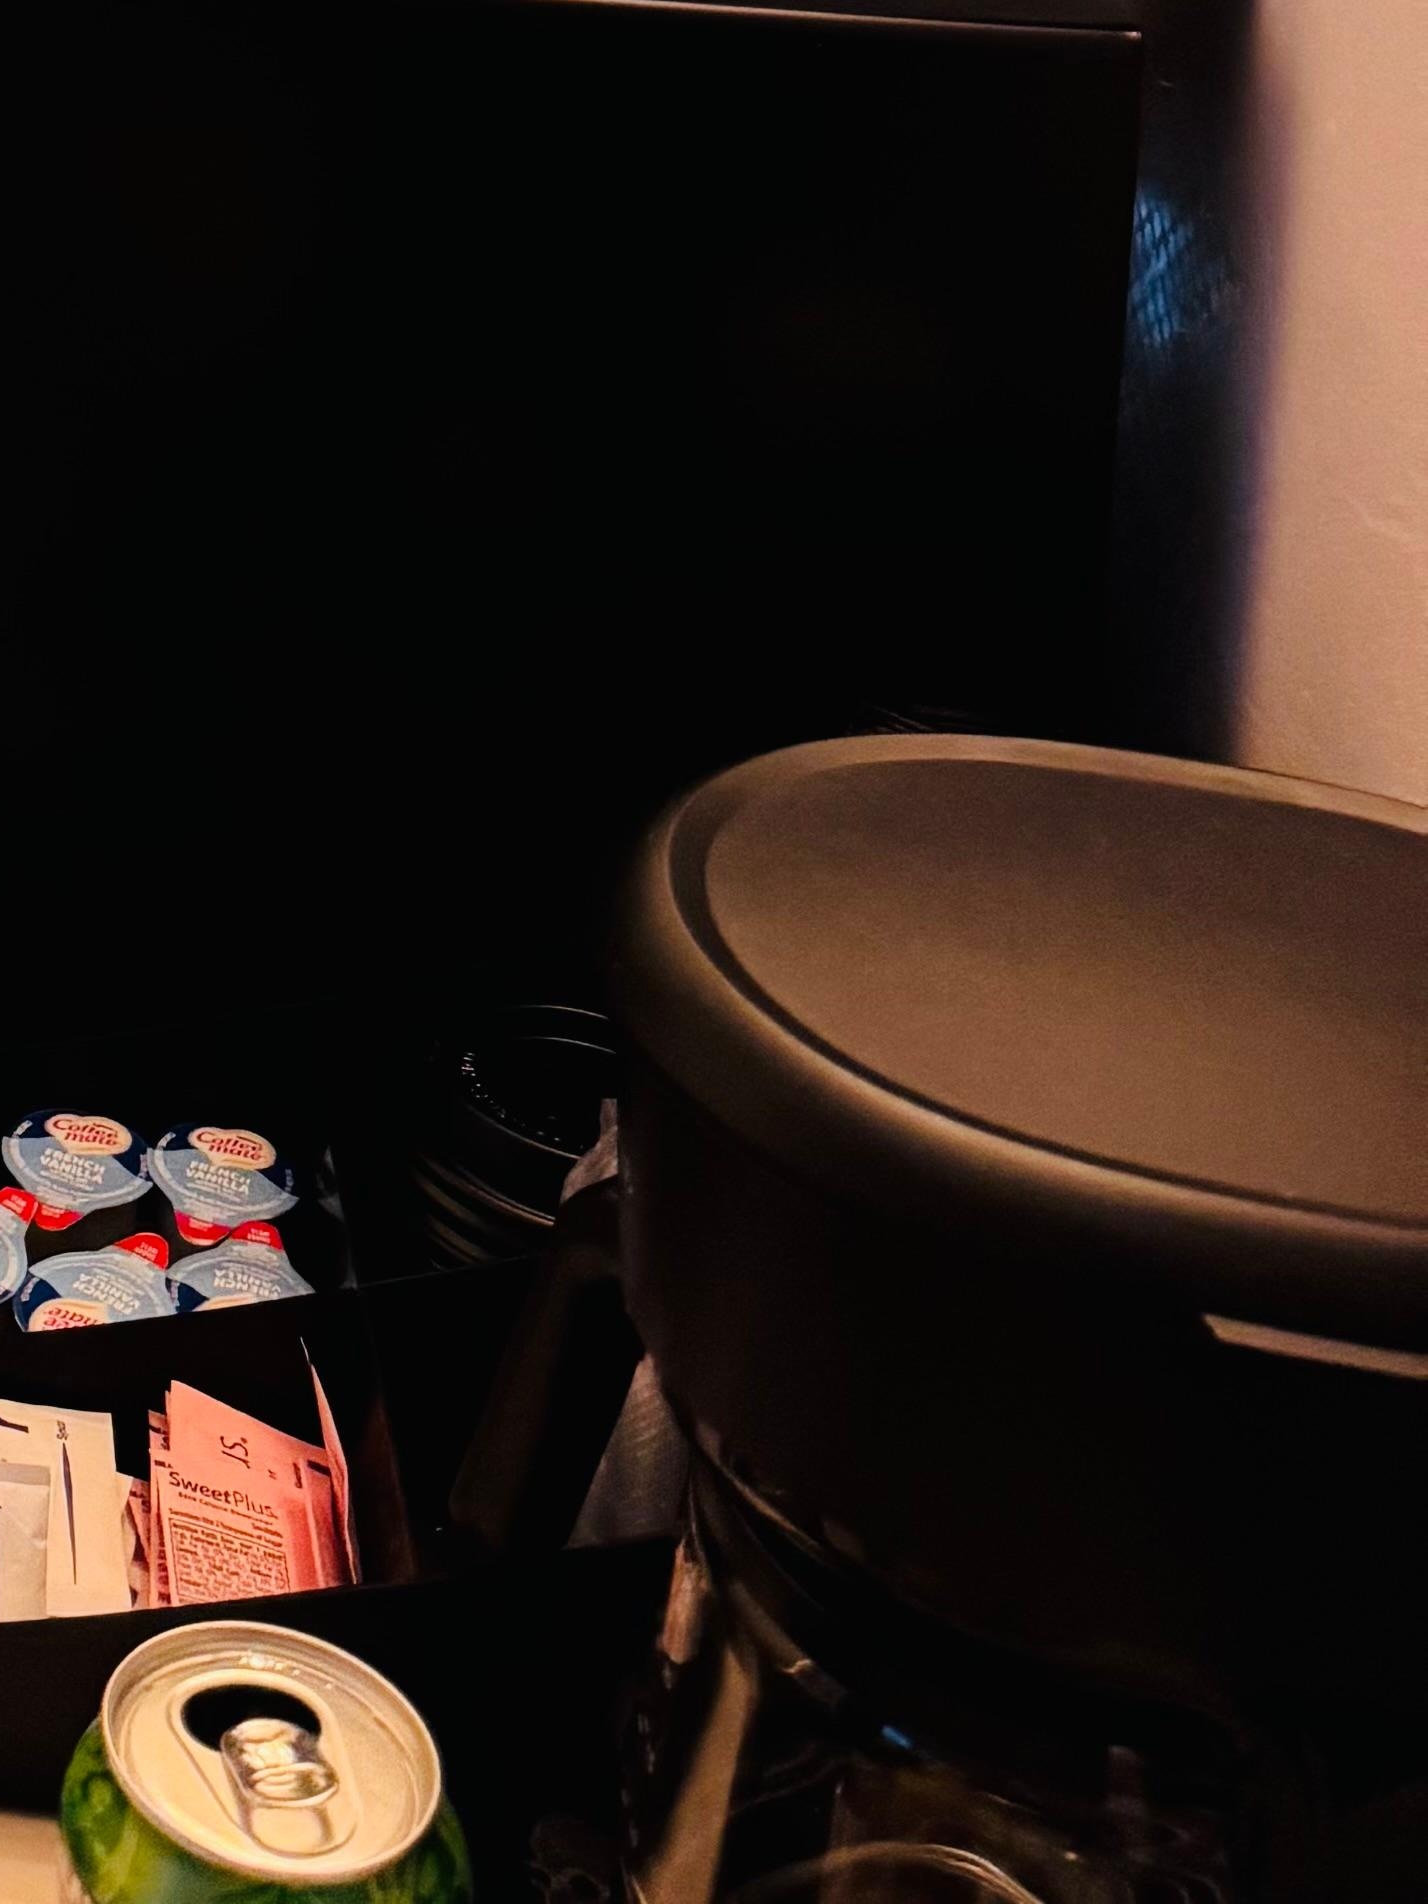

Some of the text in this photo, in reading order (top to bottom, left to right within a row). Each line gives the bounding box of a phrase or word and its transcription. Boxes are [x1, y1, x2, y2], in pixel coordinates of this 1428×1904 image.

[52, 1118, 120, 1140] Coffee
[65, 1129, 118, 1146] mate
[196, 1130, 264, 1155] Coffee
[208, 1141, 263, 1161] mate
[39, 1155, 104, 1186] VANILLA
[44, 1146, 106, 1175] FRENCH
[189, 1159, 251, 1185] FRENCH
[185, 1168, 249, 1195] VANILLA
[168, 1471, 279, 1520] SweetPlus
